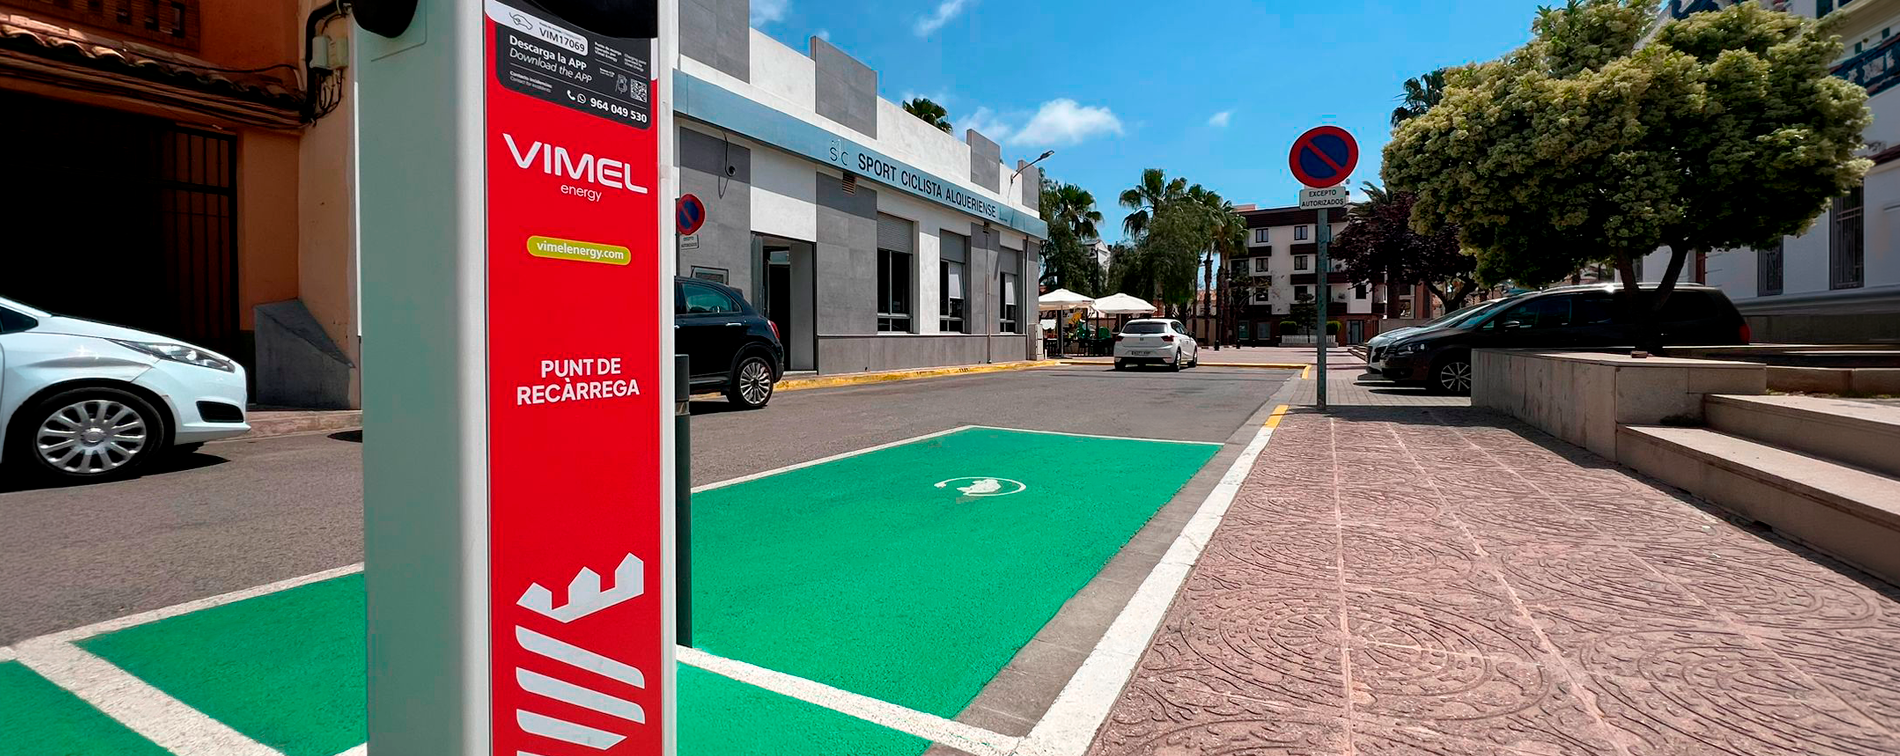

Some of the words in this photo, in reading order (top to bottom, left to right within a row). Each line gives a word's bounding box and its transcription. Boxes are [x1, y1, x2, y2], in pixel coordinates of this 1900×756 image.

[539, 27, 585, 52] VIM17069
[509, 35, 555, 61] Descarga
[557, 52, 566, 63] la
[568, 58, 587, 71] APP
[509, 47, 557, 73] Download
[559, 64, 573, 78] the
[574, 71, 592, 84] APP
[590, 97, 609, 112] 964
[610, 104, 629, 118] 049
[630, 110, 647, 123] 530
[502, 133, 648, 194] VIMEL
[560, 183, 602, 202] energy
[858, 152, 897, 182] SPORT
[901, 170, 942, 199] CICLISTA
[946, 187, 997, 218] ALQUERIENSE
[1309, 189, 1336, 197] EXCEPTO
[1302, 199, 1343, 207] AUTORIZADOS
[537, 241, 624, 259] vimelenergy.com
[541, 358, 594, 378] PUNT
[597, 357, 621, 376] DE
[517, 378, 640, 406] RECÀRREGA
